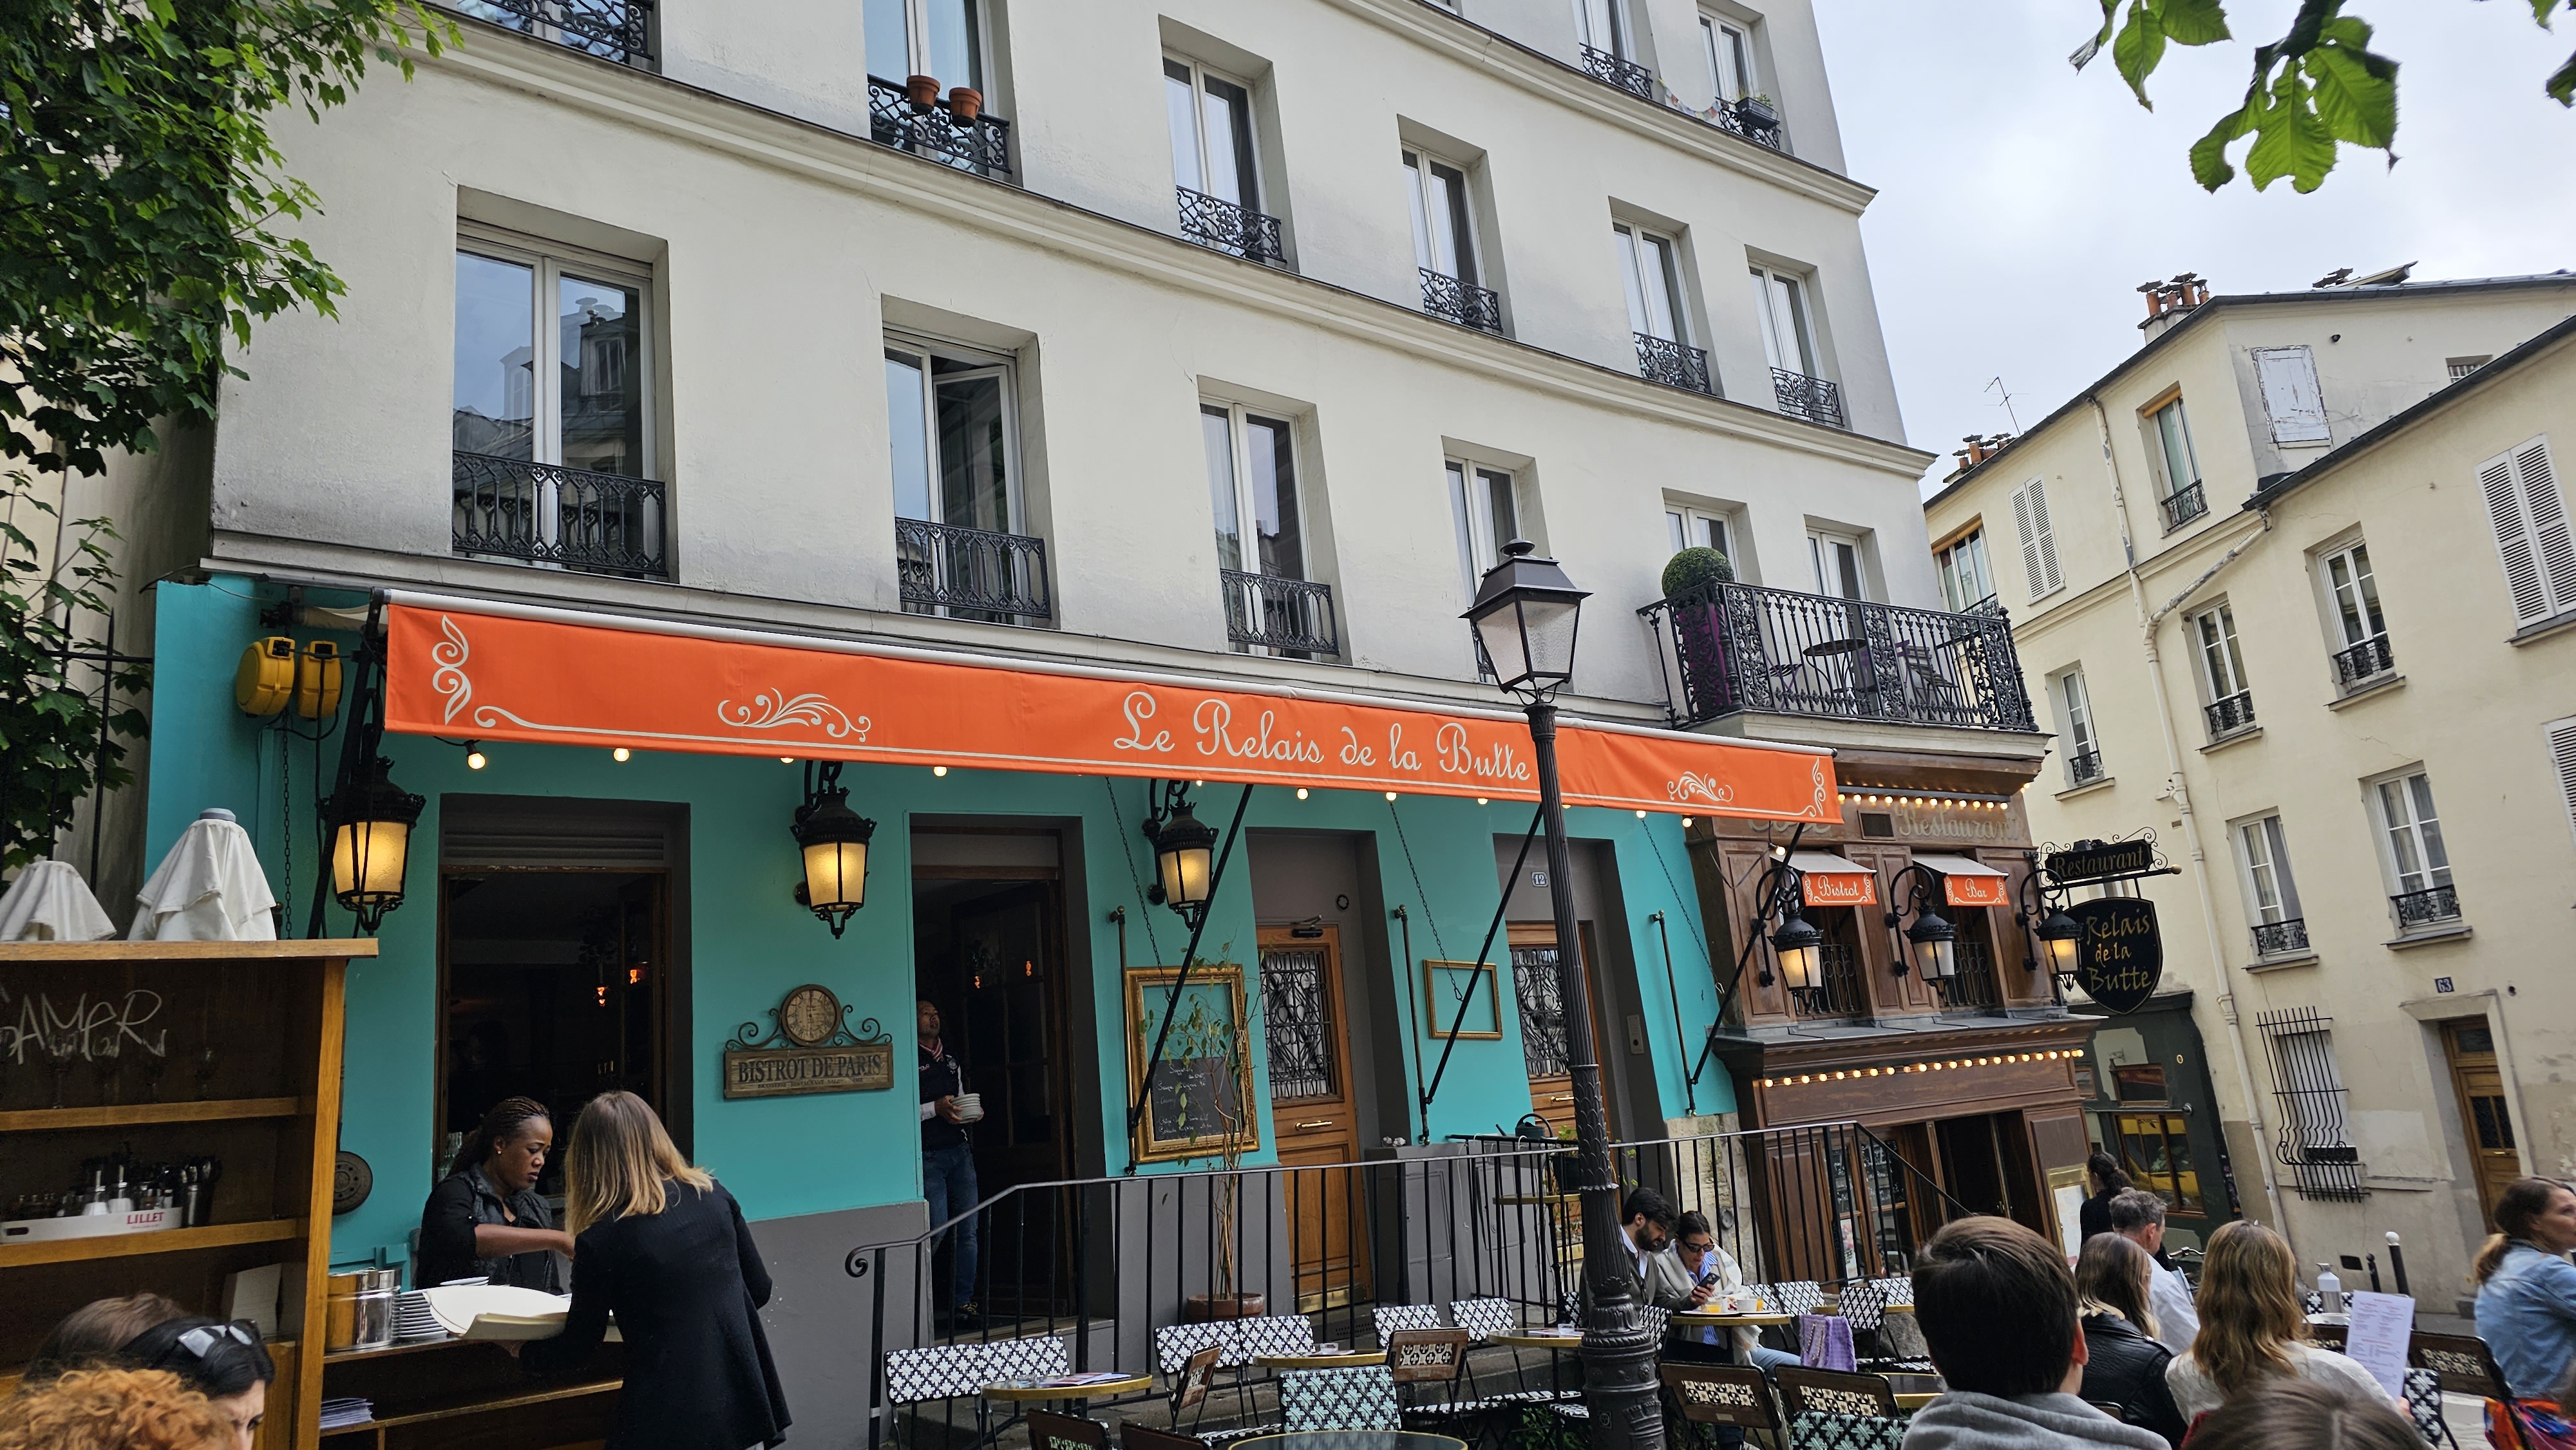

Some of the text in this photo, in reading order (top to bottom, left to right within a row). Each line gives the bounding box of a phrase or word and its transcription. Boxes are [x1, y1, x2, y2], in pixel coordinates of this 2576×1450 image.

[1113, 691, 1531, 781] Le Relais de la Butte
[2054, 845, 2144, 878] Restaurant
[1534, 874, 1546, 885] 12
[1818, 875, 1859, 896] Bistrot
[1965, 878, 1988, 898] Bar
[2086, 908, 2150, 945] Relais
[2095, 941, 2132, 968] de la
[2087, 966, 2152, 993] Butte
[2438, 979, 2452, 992] 63
[738, 1053, 882, 1083] BISTROT DE PARIS
[127, 1212, 165, 1225] LILLET
